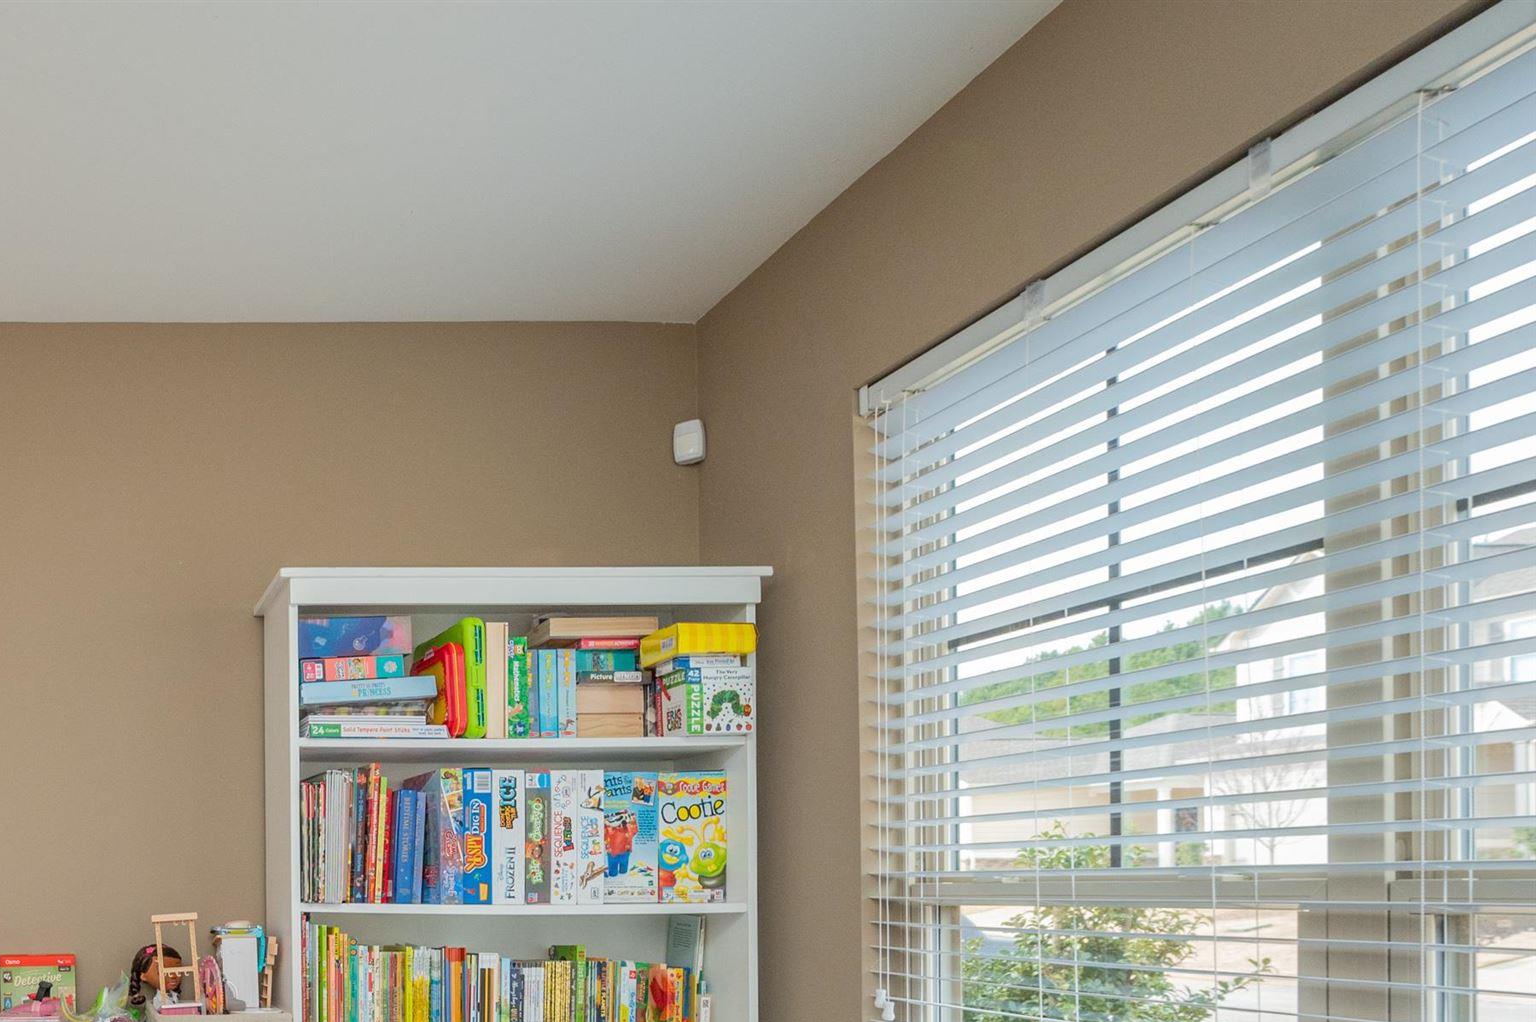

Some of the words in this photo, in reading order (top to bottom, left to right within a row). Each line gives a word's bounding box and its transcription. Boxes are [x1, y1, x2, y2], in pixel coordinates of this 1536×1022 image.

[687, 669, 700, 677] 42
[691, 684, 701, 732] PUZZLE
[312, 725, 324, 735] 24
[604, 776, 623, 787] nts
[499, 776, 517, 807] ICE
[605, 785, 632, 798] ants
[471, 802, 480, 813] IN
[661, 795, 725, 824] Cootie
[471, 815, 480, 834] DIG
[554, 811, 563, 857] SEQUENCE
[401, 831, 410, 863] STORIES
[465, 834, 482, 854] SPY
[580, 816, 589, 859] SEQUENCE
[505, 847, 515, 855] II
[505, 857, 515, 899] FROZEN
[14, 971, 64, 987] Detective
